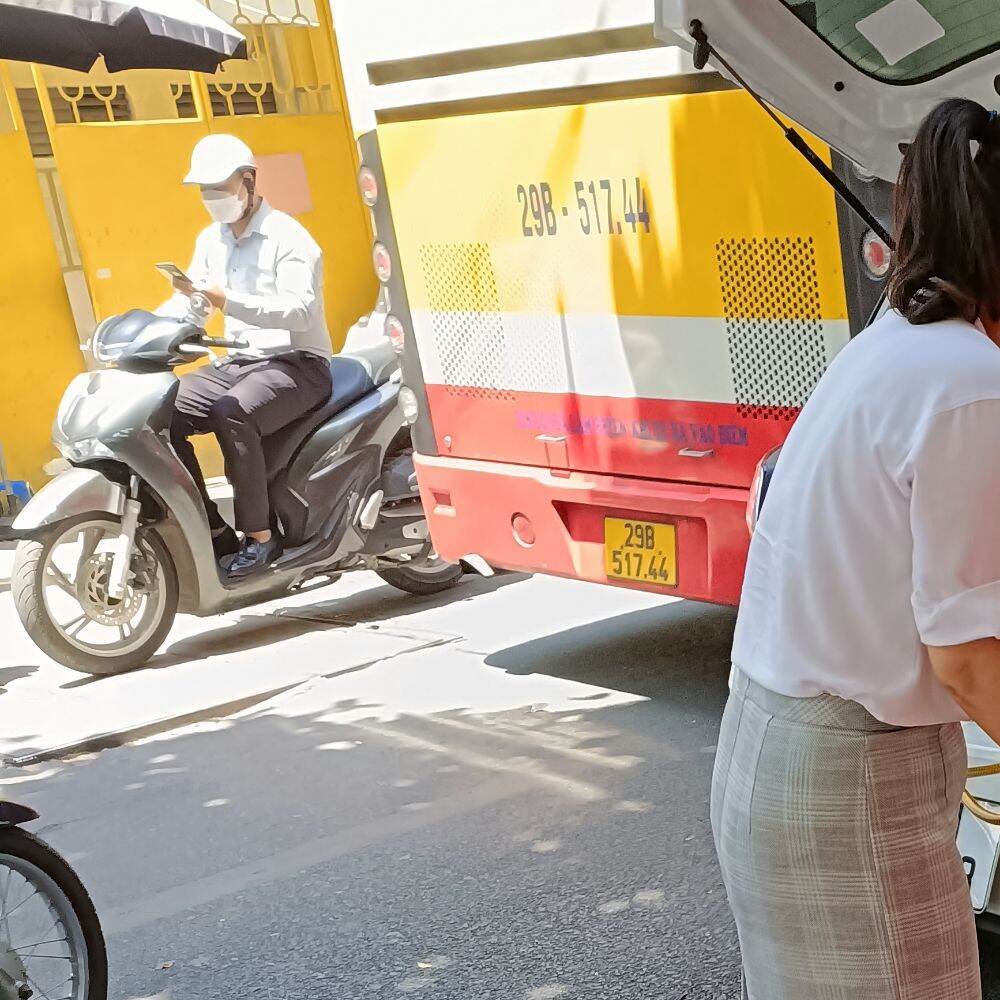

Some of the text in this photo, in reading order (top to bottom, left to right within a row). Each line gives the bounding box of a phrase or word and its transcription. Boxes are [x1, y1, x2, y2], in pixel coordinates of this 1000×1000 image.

[517, 182, 557, 237] 29B
[574, 177, 650, 235] 517.44
[624, 523, 655, 550] 29B
[612, 550, 669, 581] 517.44
